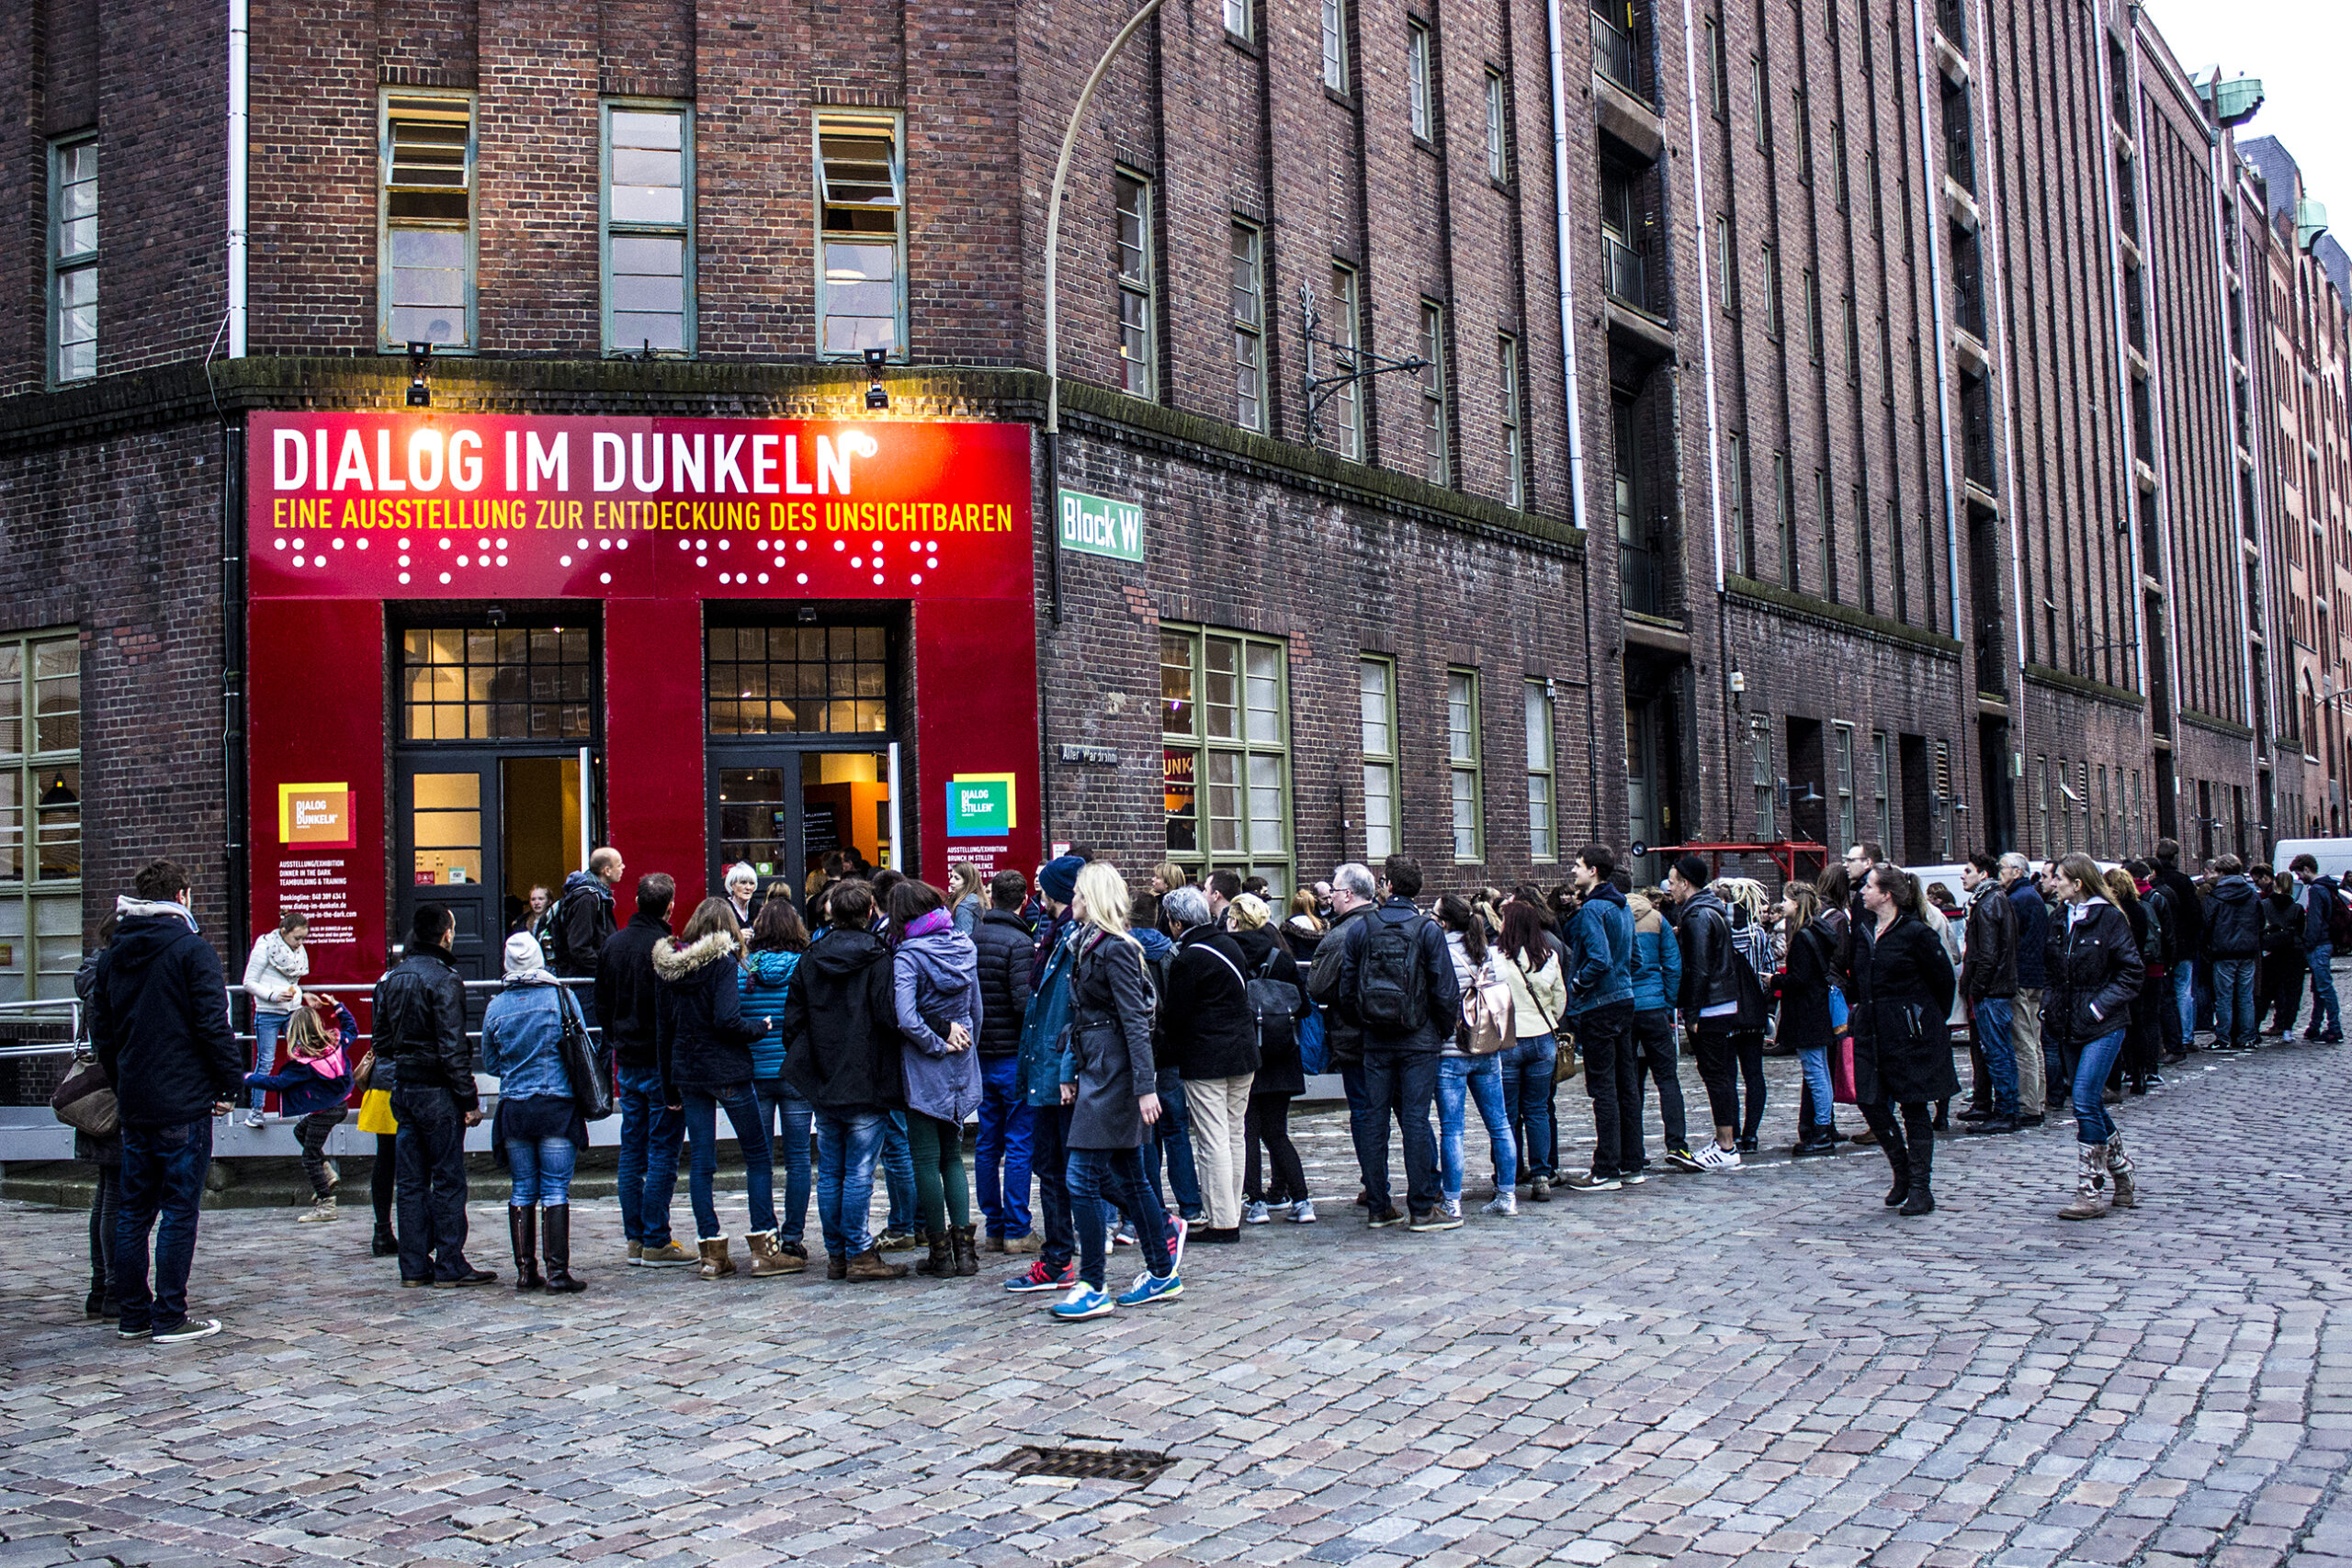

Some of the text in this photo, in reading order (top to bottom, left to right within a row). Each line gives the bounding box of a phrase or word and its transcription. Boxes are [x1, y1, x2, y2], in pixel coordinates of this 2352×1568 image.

[274, 428, 483, 492] DIALOG
[505, 430, 569, 492] IM
[274, 498, 1012, 532] EINE AUSSTELLUNG ZUR ENTDECKUNG DES UNSICHTBAREN
[1063, 496, 1139, 552] Block W
[961, 789, 989, 799] DIALOG
[296, 800, 326, 810] DIALOG
[947, 846, 1008, 854] AUSSTELLUNG/EXHIBITION
[279, 860, 345, 868] AUSSTELLUNG/EXHIBITION
[279, 869, 300, 877] DINNER
[317, 868, 332, 876] DARK
[279, 878, 317, 886] TEAMBUILDING
[322, 877, 347, 886] TRAINING
